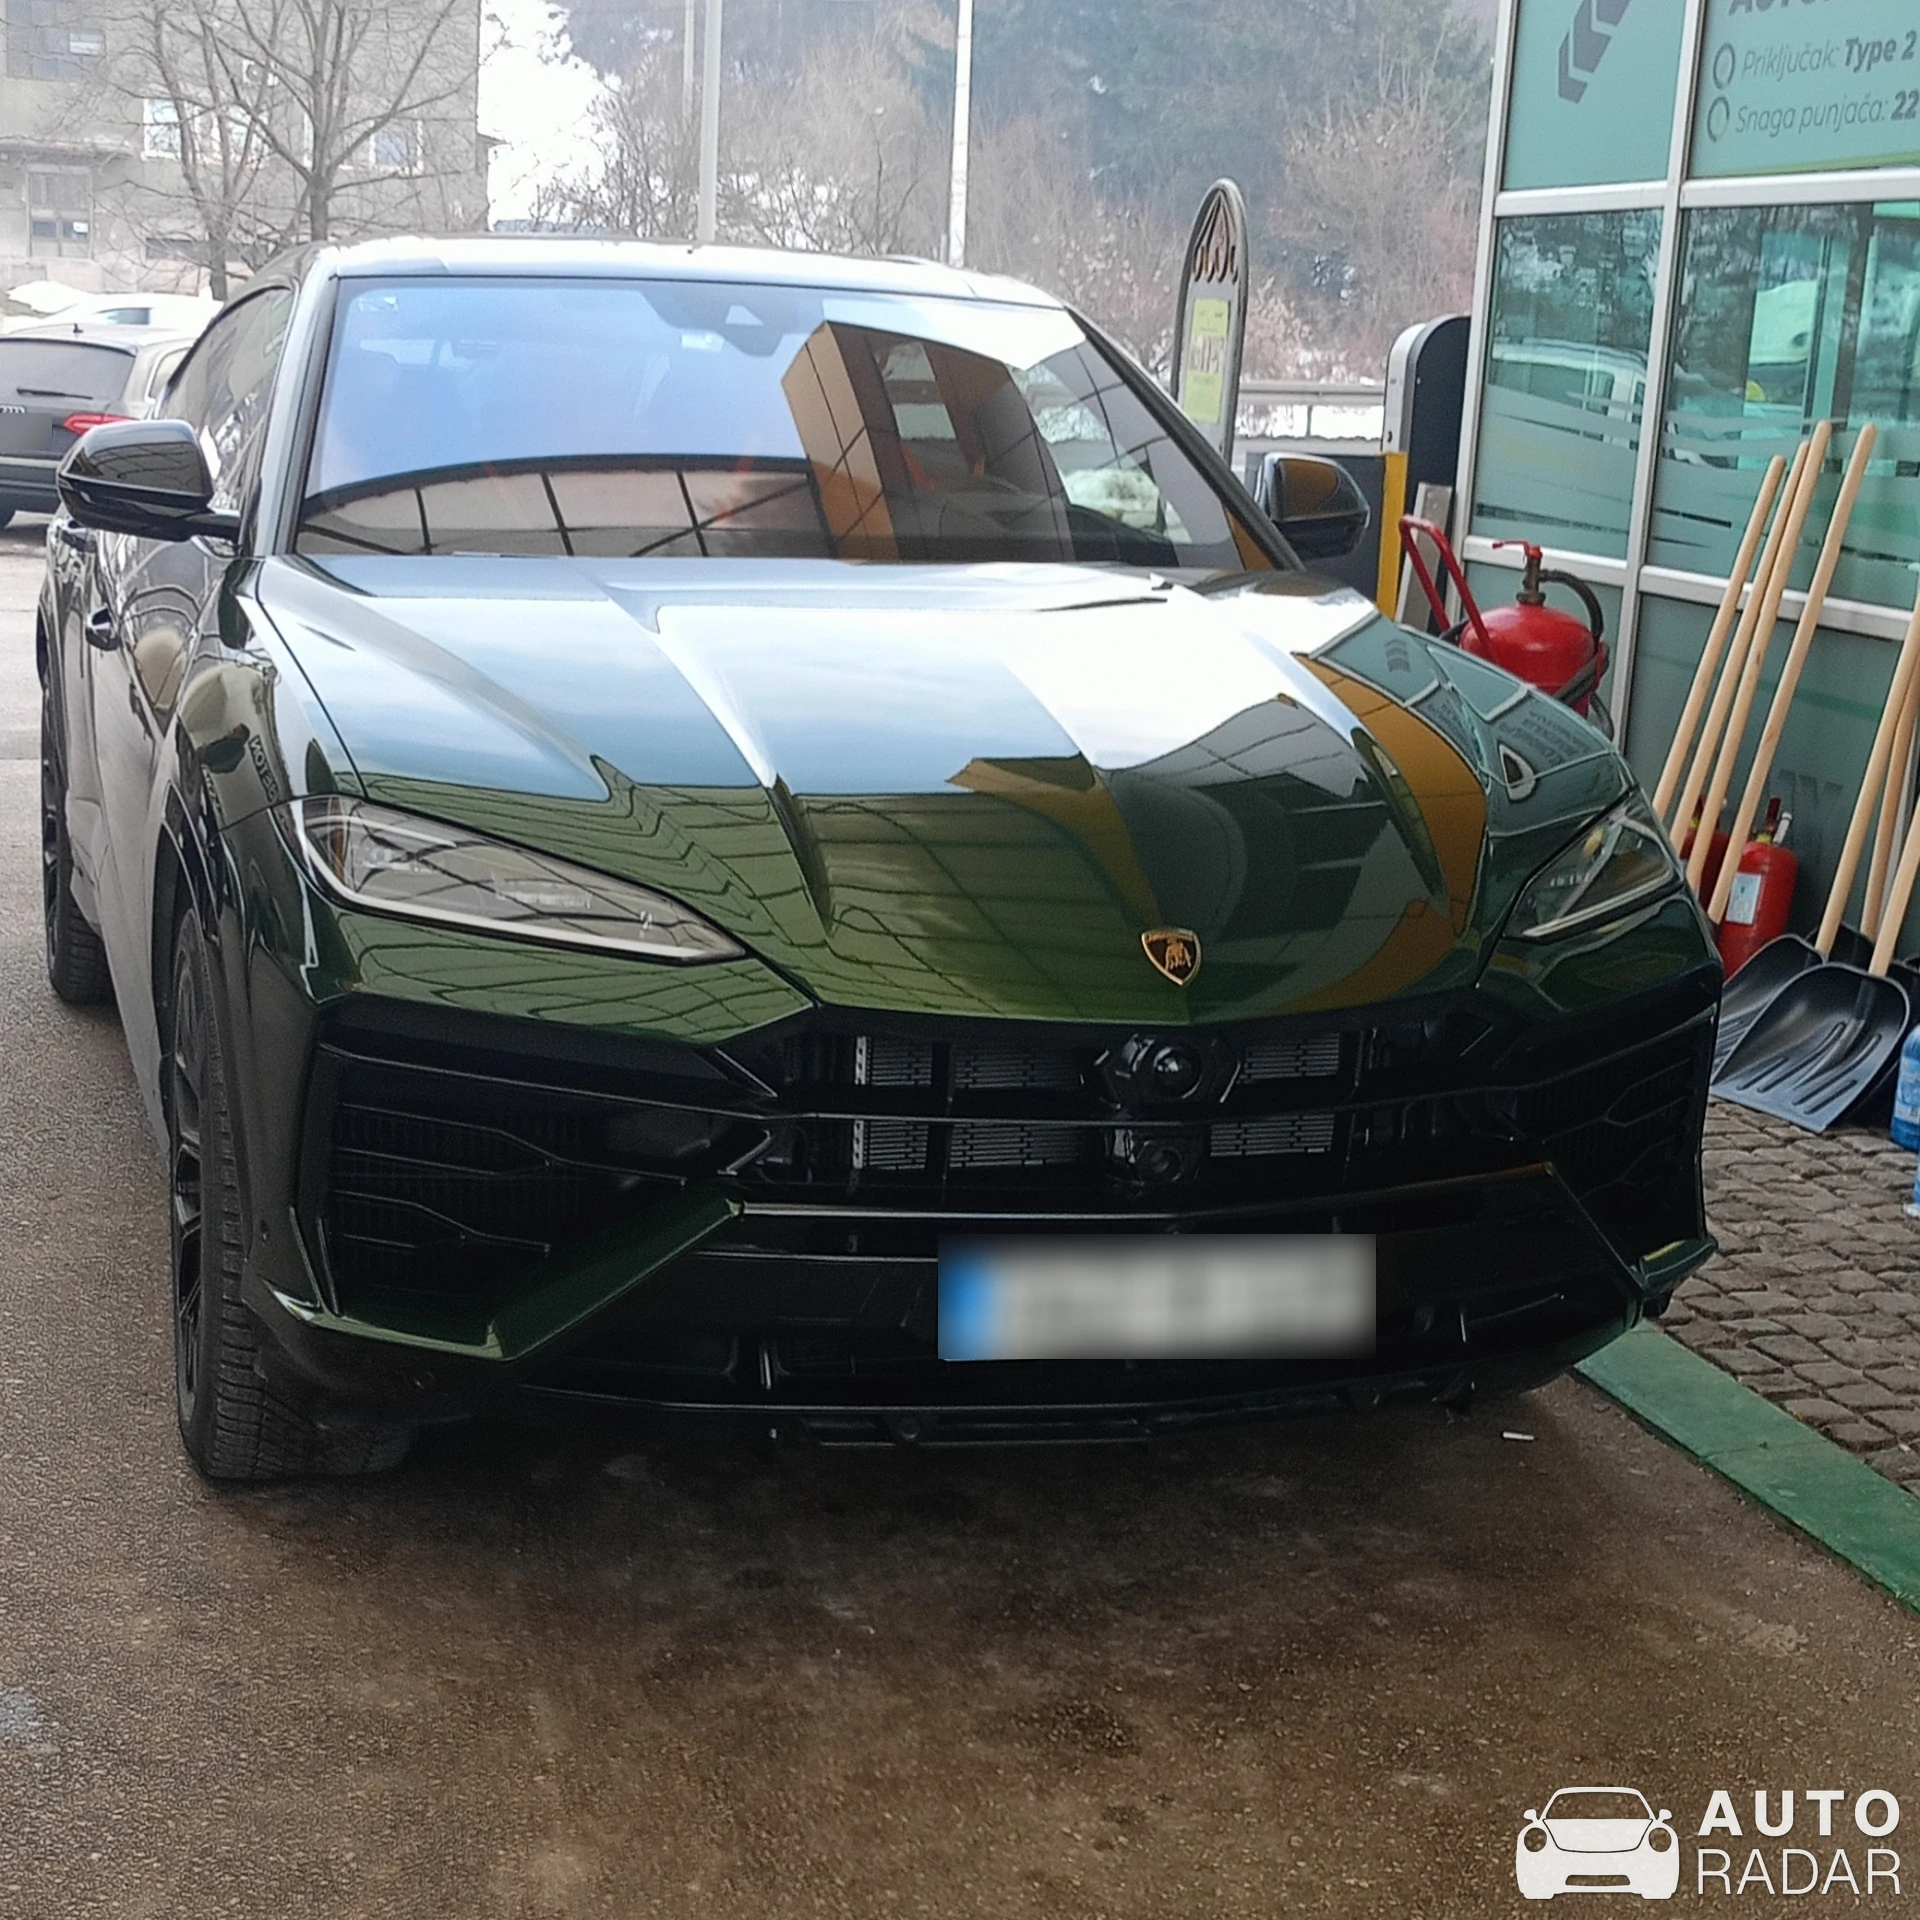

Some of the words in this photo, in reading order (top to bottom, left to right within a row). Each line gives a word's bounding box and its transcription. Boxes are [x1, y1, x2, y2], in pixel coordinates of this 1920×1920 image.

[1741, 39, 1840, 82] Priključak:
[1845, 36, 1897, 73] Type
[1901, 29, 1917, 61] 2
[1735, 105, 1796, 138] Snaga
[1891, 89, 1920, 121] 22
